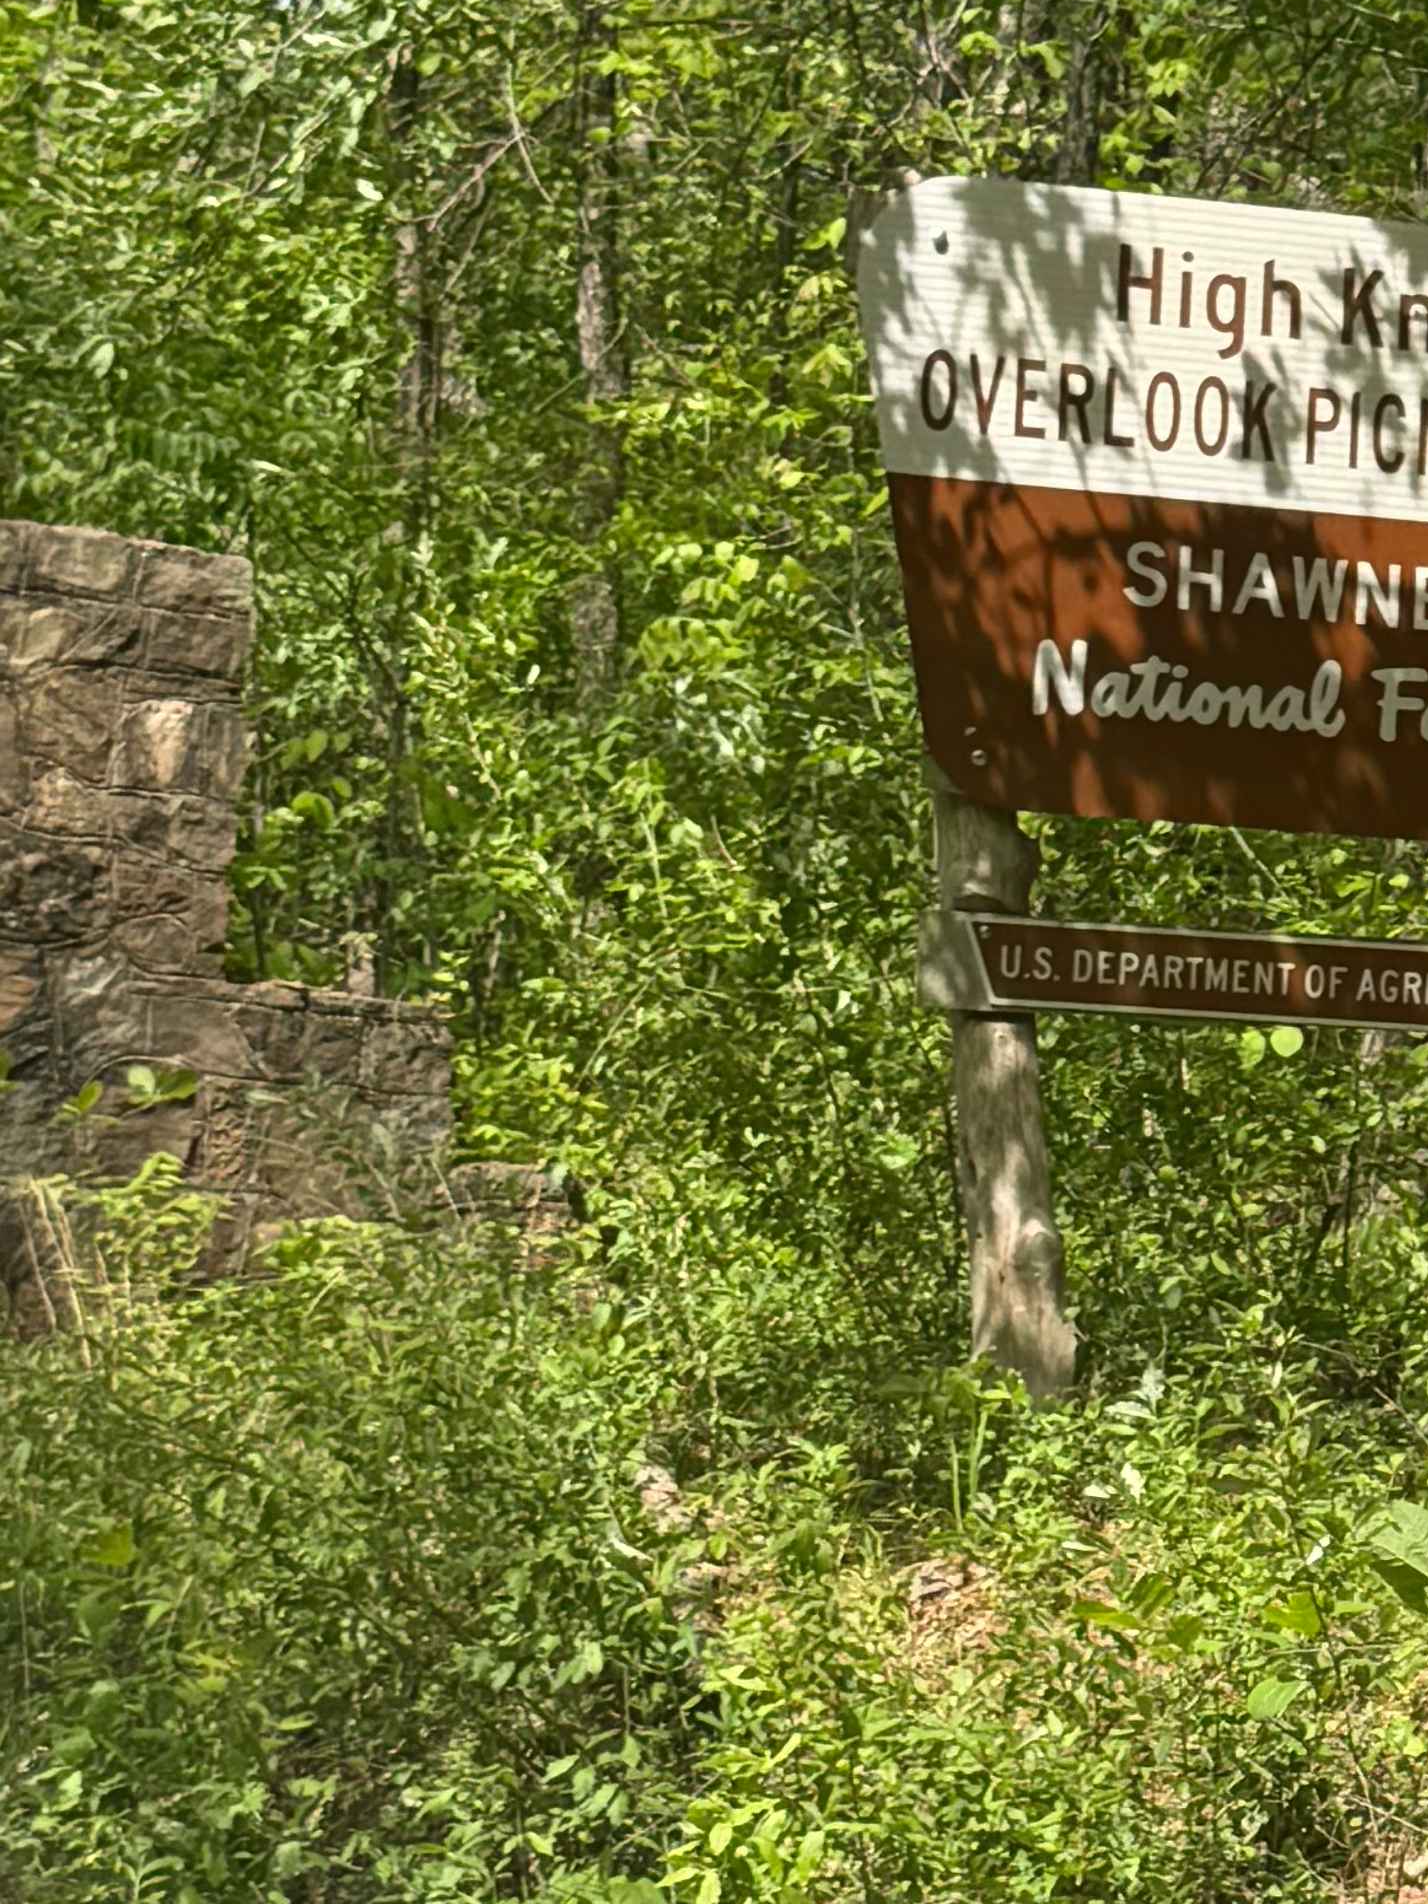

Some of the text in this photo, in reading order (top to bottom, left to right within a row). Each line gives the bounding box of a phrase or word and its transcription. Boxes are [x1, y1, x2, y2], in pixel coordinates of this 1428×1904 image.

[1117, 244, 1302, 358] High
[921, 349, 1275, 462] OVERLOOK
[1032, 638, 1345, 737] National
[1000, 951, 1060, 984] U.S.
[1072, 953, 1294, 998] DEPARTMENT
[1304, 965, 1343, 998] OF
